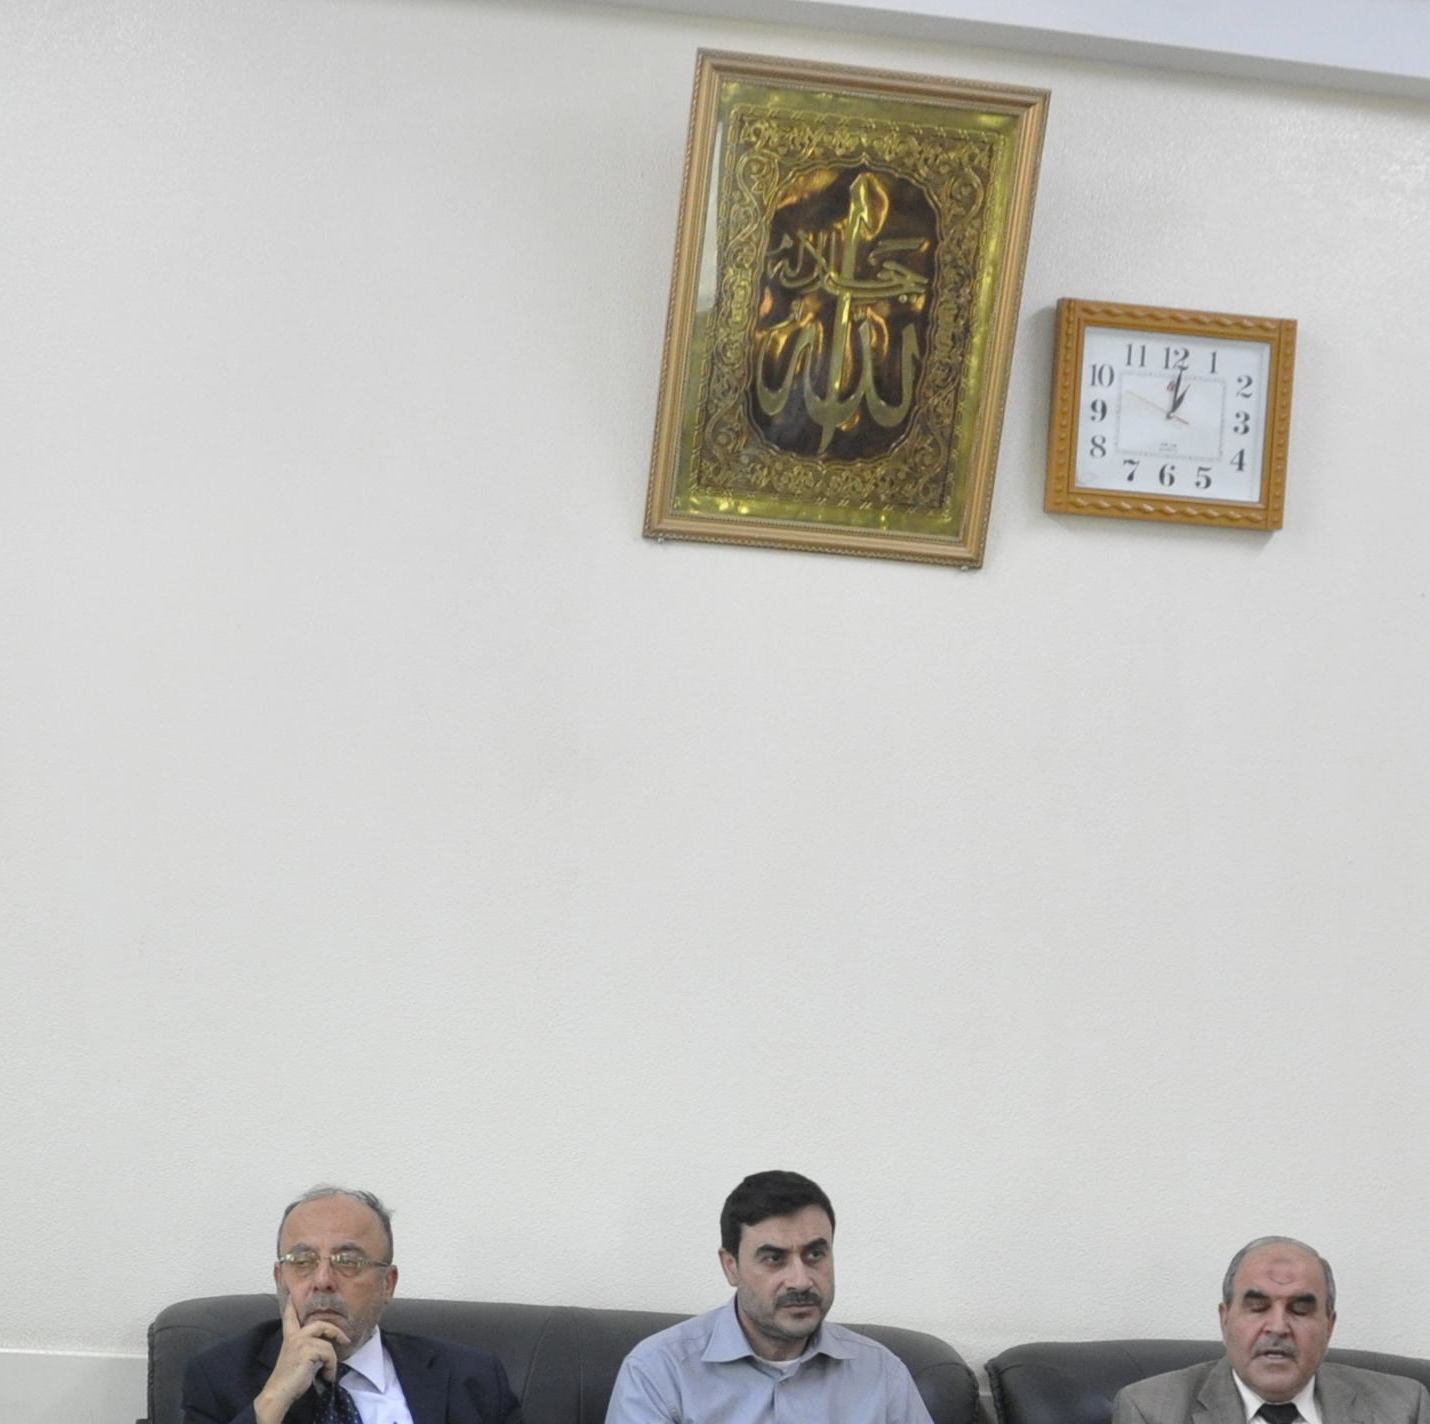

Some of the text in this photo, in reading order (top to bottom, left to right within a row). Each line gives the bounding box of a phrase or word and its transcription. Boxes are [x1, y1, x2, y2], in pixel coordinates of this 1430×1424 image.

[1125, 343, 1146, 367] 11
[1163, 346, 1190, 371] 12
[1209, 351, 1218, 374] 1
[1089, 364, 1114, 387] 10
[1236, 375, 1253, 398] 2
[1090, 398, 1107, 422] 9
[1233, 411, 1250, 434] 3
[1089, 434, 1106, 458] 8
[1123, 459, 1140, 481] 7
[1230, 448, 1246, 471] 4
[1159, 464, 1176, 486] 6
[1195, 467, 1212, 489] 5
